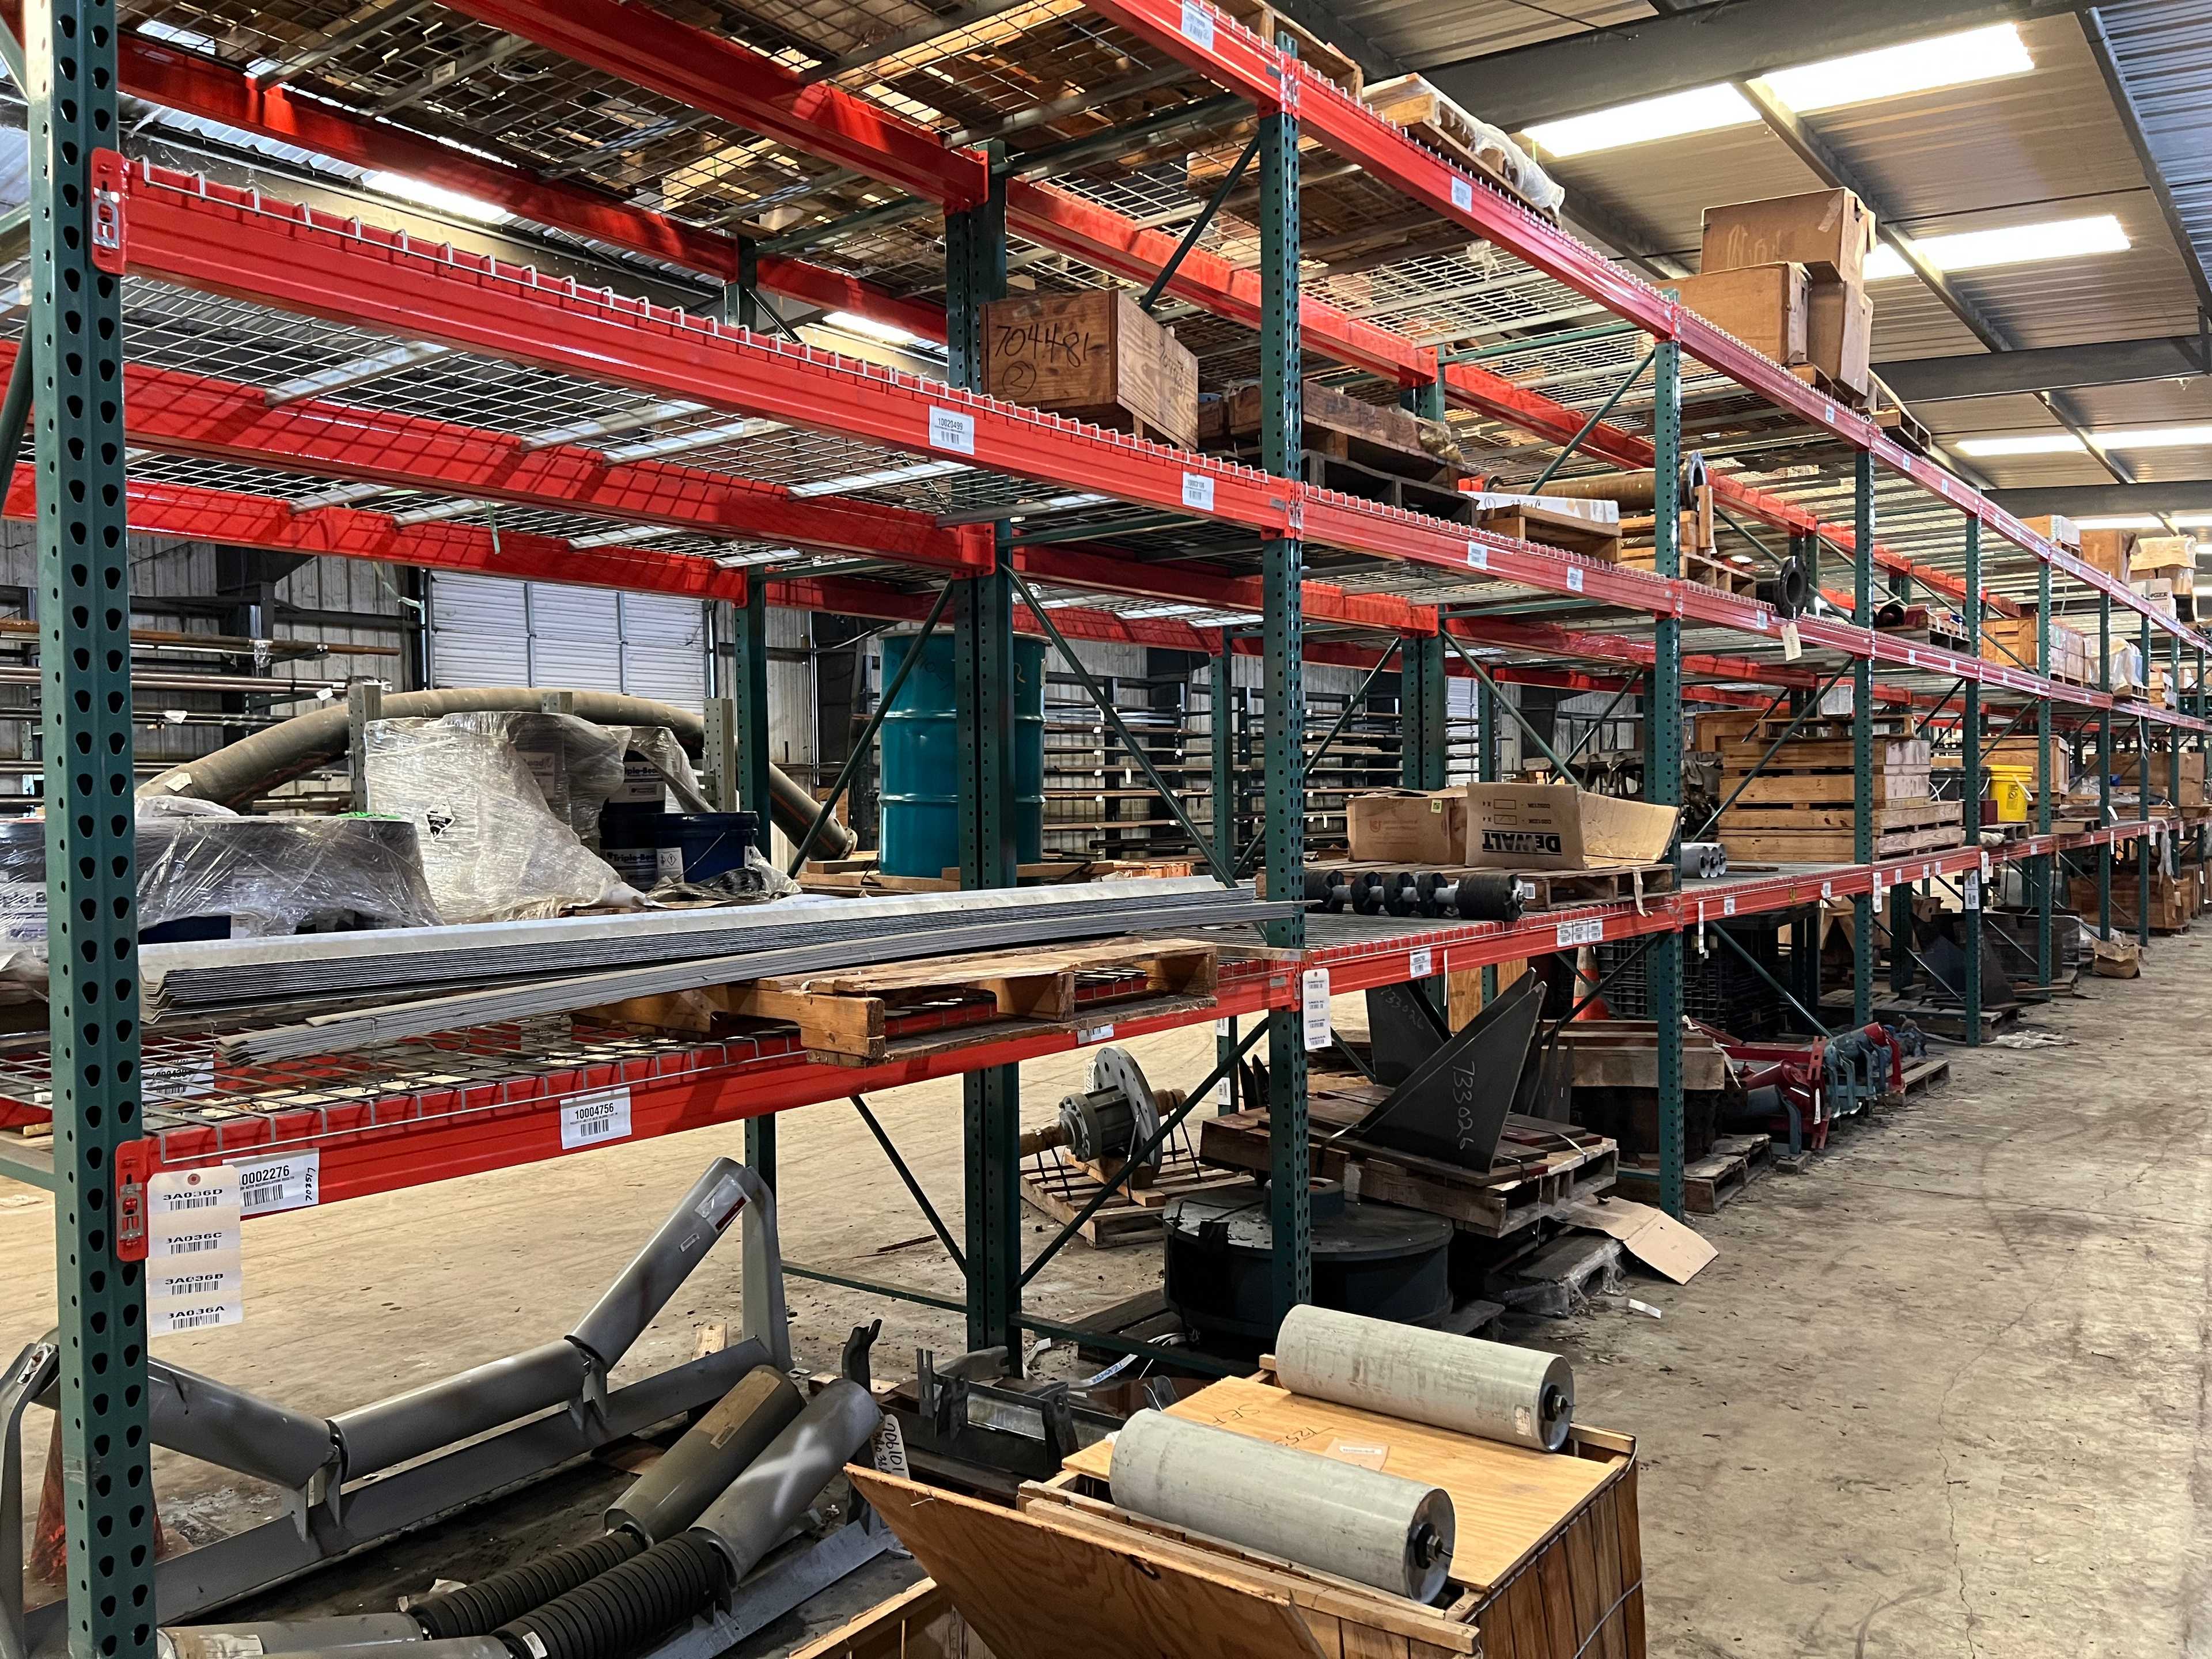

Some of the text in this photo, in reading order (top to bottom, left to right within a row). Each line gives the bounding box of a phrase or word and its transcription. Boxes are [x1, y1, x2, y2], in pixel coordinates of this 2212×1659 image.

[995, 323, 1089, 368] 704481
[575, 1103, 614, 1120] 10004756
[1452, 1060, 1475, 1150] 733026
[240, 1165, 290, 1185] 0002276
[163, 1189, 223, 1200] 3A036D
[165, 1274, 224, 1285] 3A036B
[168, 1306, 225, 1319] 3A036A
[882, 1422, 904, 1471] 706101
